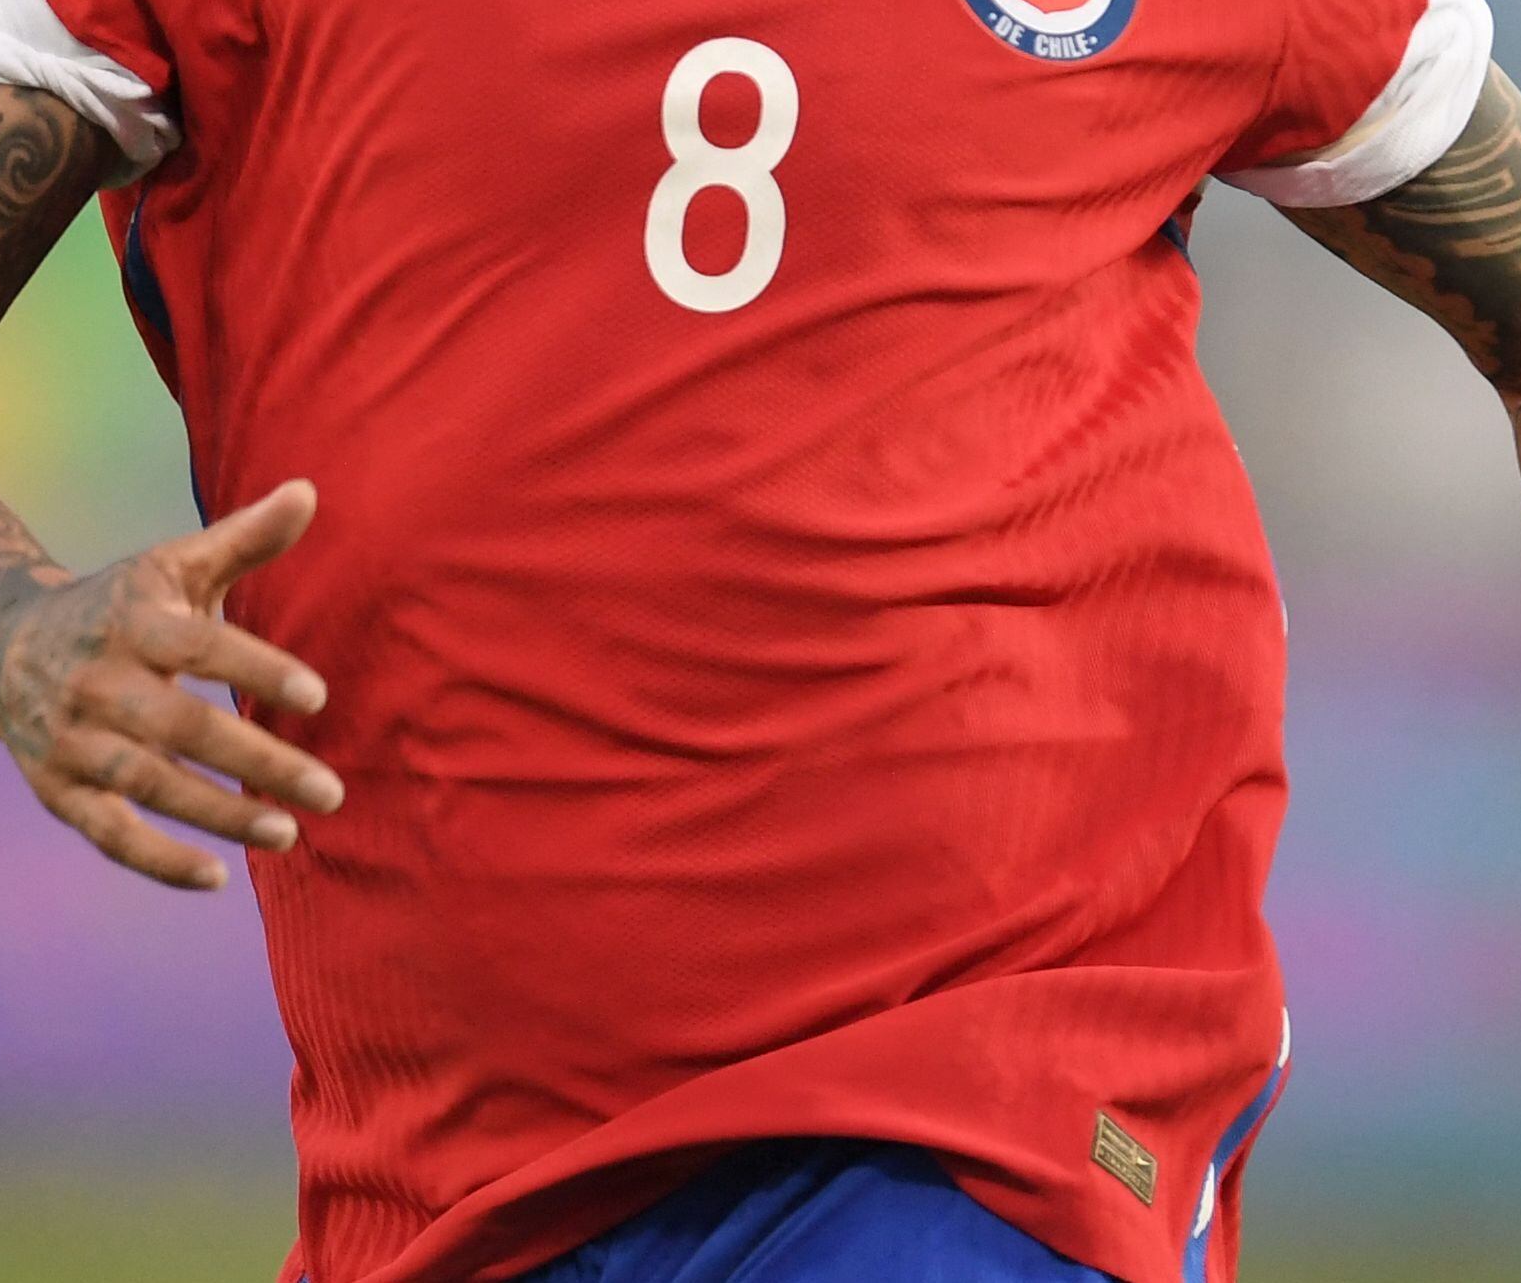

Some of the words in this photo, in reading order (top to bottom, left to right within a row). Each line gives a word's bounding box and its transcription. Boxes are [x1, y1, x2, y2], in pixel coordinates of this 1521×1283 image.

[994, 14, 1026, 47] DE
[1033, 33, 1090, 58] CHILE
[644, 36, 800, 314] 8
